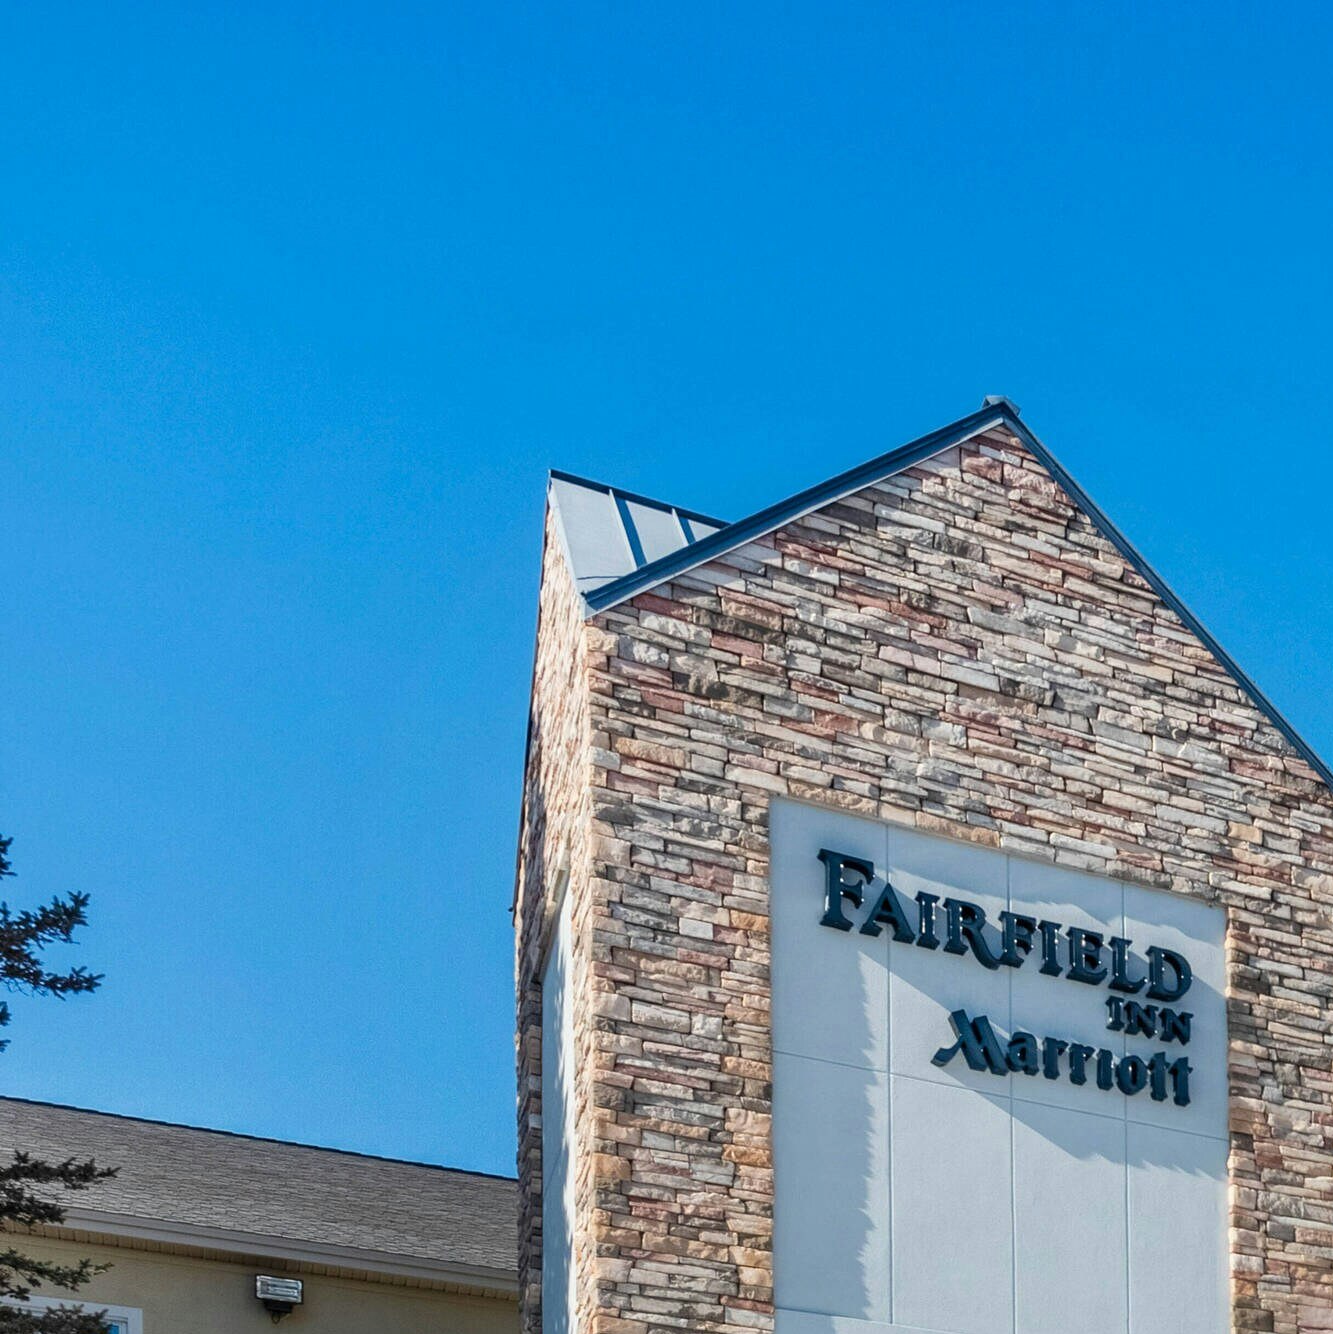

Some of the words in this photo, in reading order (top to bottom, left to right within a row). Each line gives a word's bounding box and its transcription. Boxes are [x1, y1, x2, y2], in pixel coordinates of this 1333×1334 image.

[817, 847, 1193, 1001] FAIRFIELD
[930, 1008, 1194, 1107] Marriott
[1105, 995, 1194, 1046] INN
